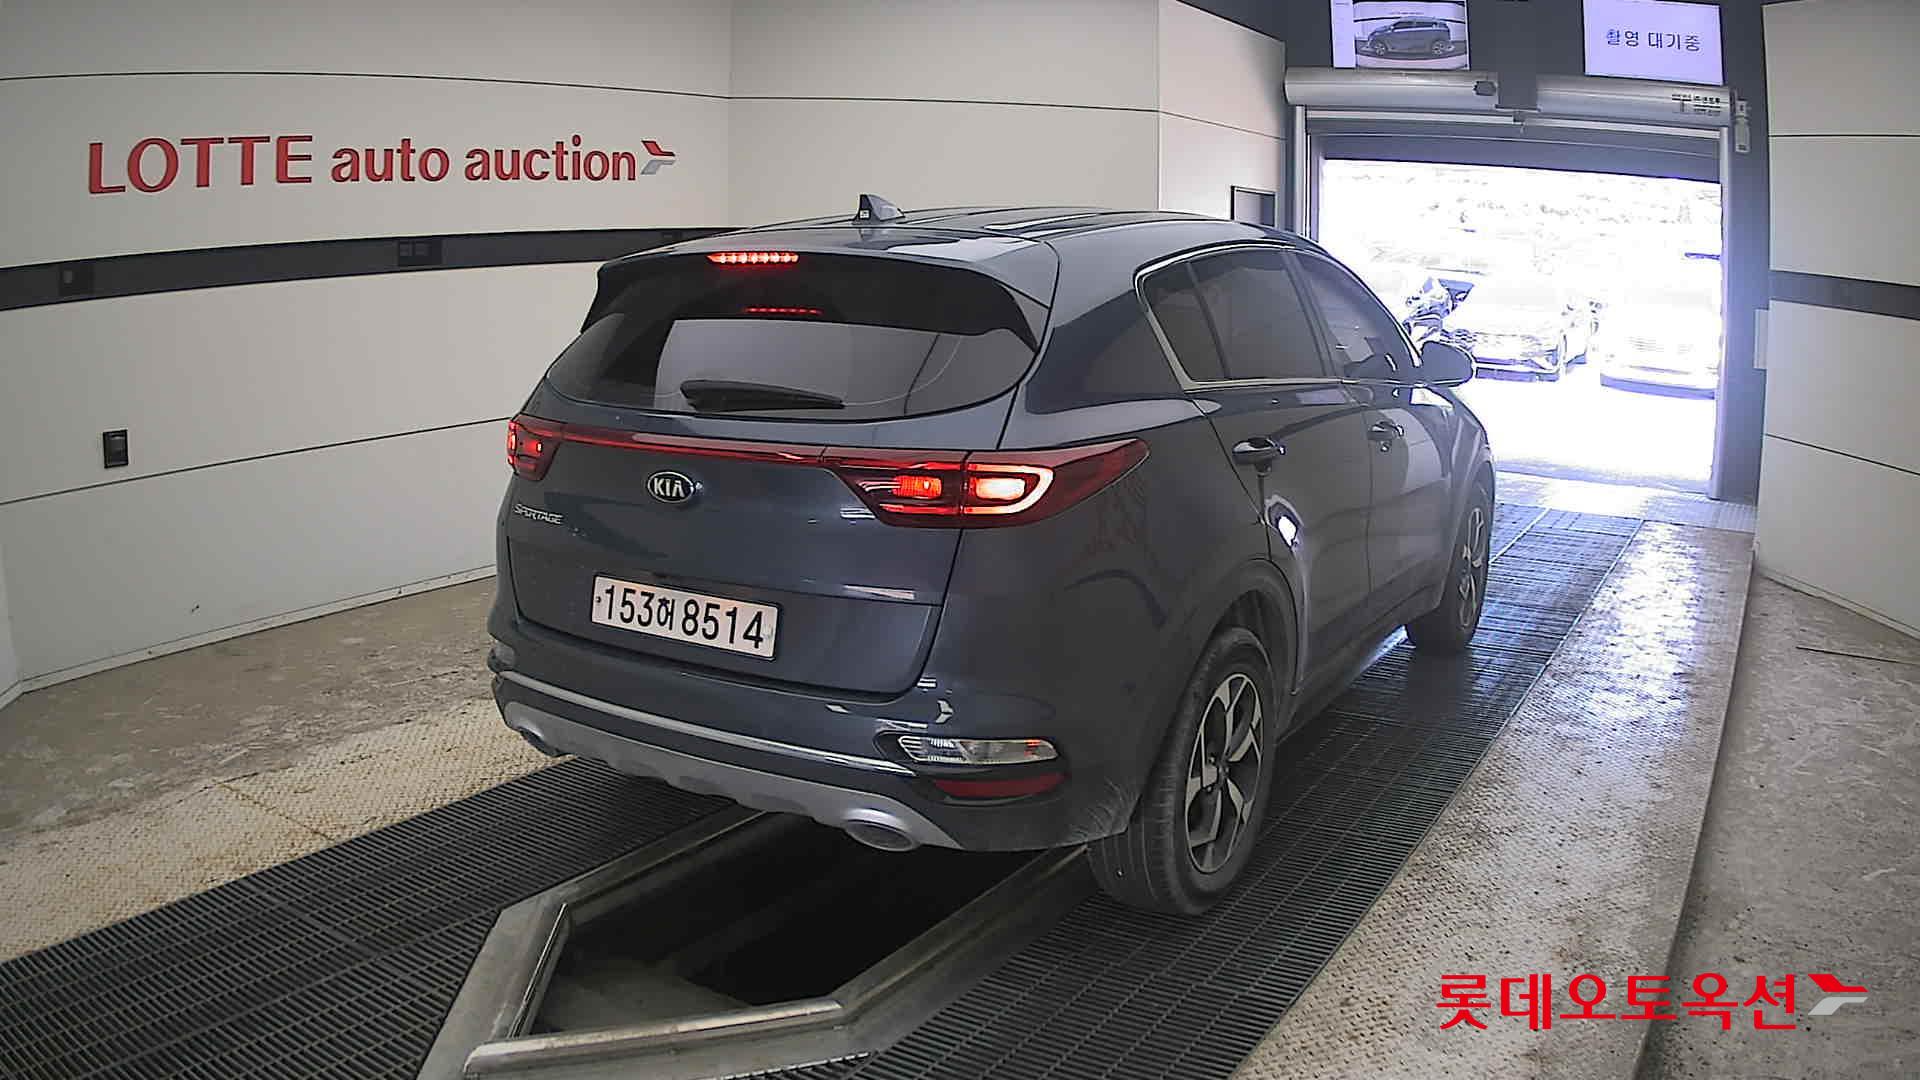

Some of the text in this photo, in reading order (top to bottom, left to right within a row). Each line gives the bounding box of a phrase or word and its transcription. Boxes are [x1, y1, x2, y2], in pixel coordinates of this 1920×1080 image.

[1648, 32, 1700, 51] 대기중
[89, 135, 636, 194] LOTTE auto auction
[653, 478, 686, 498] KIA
